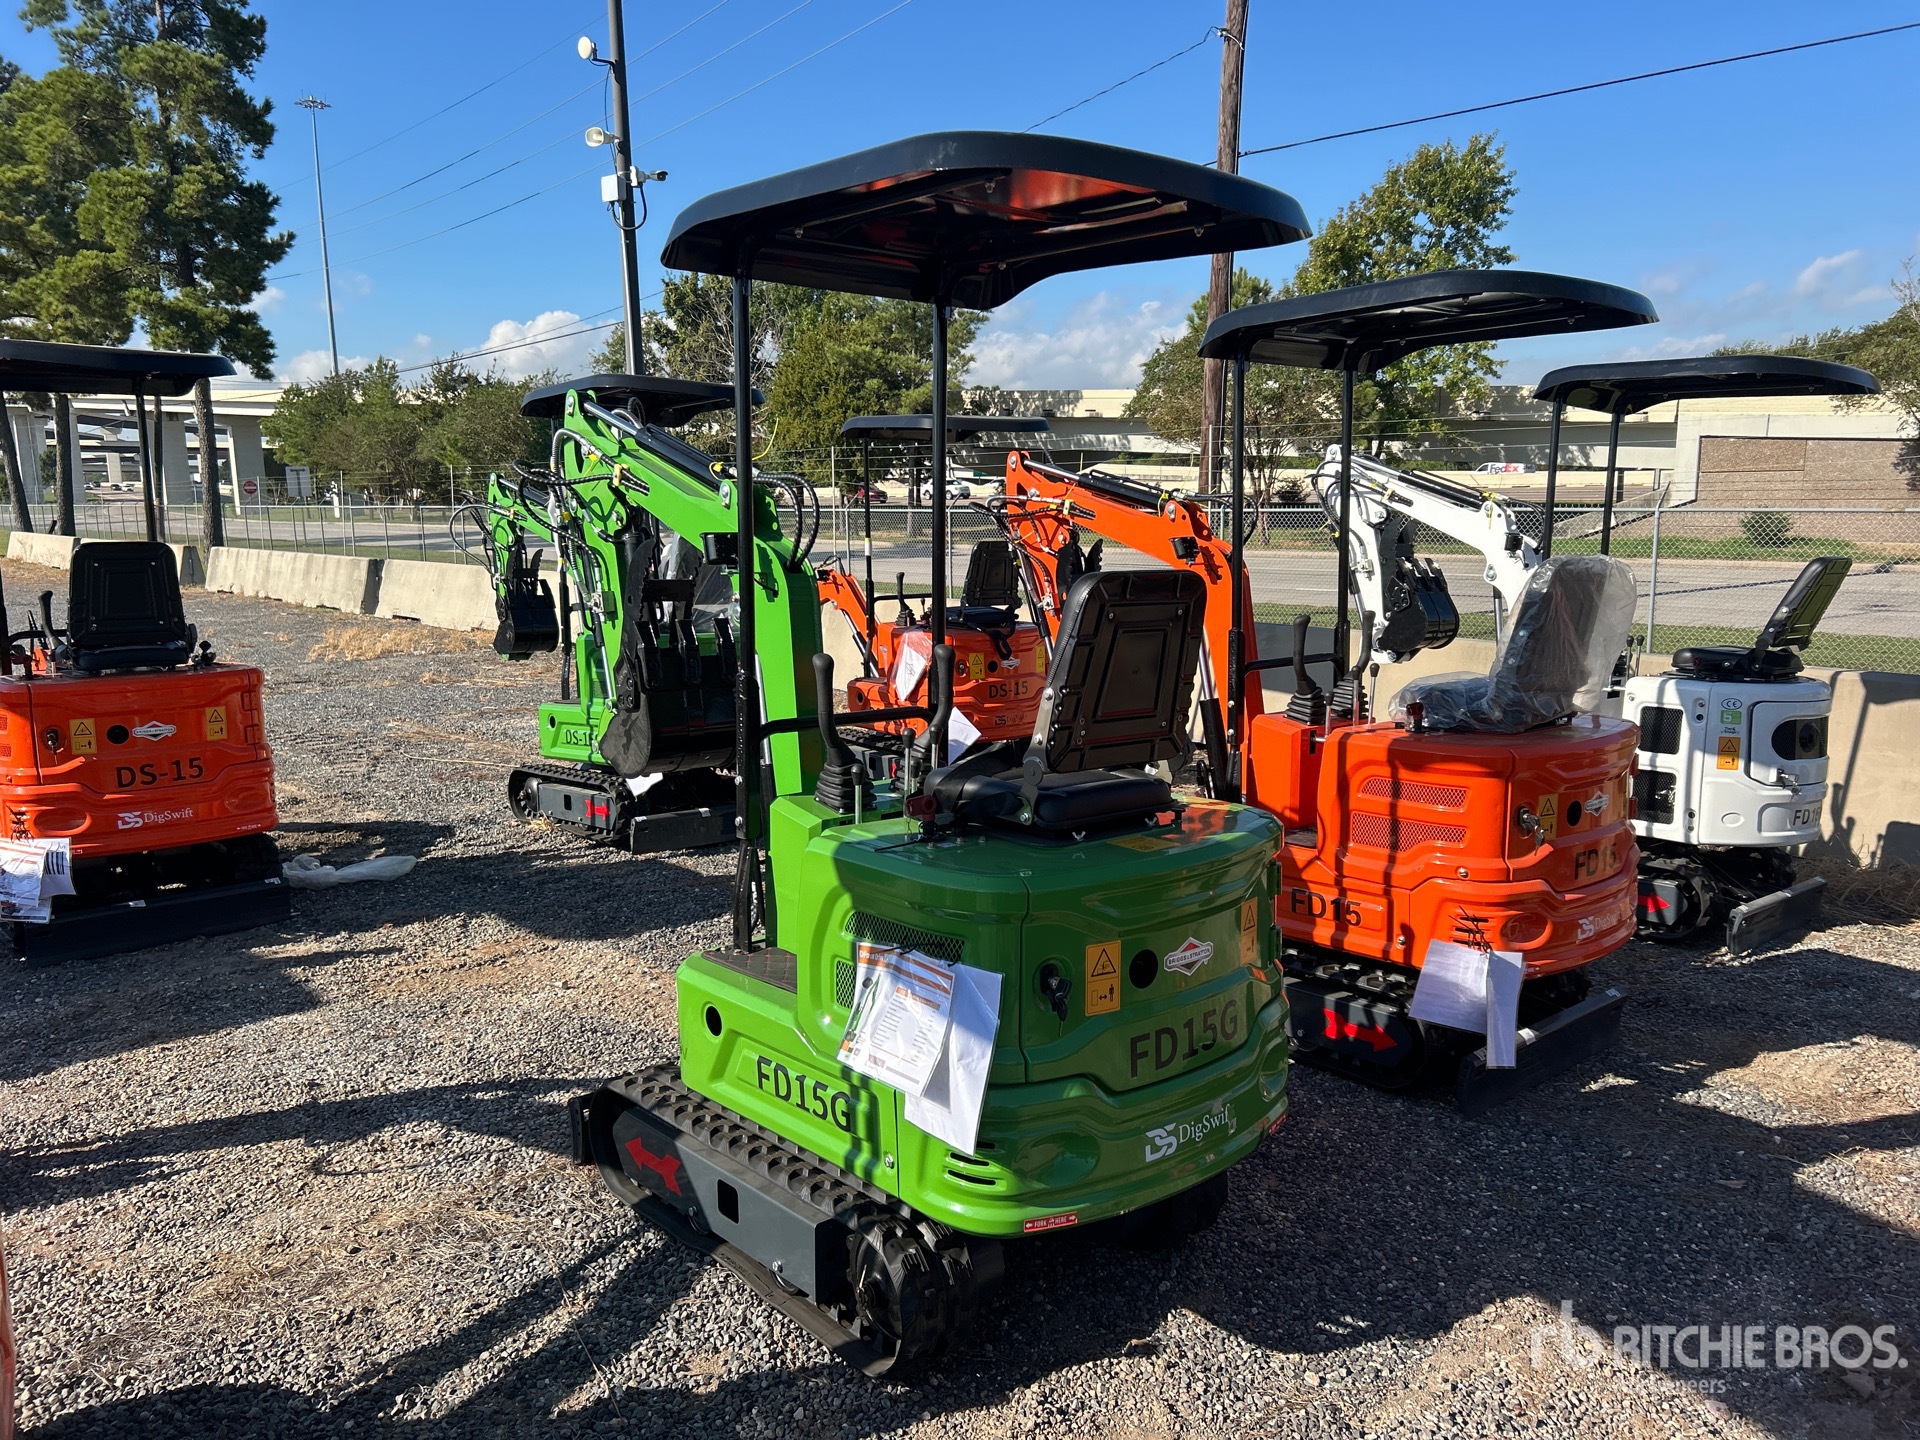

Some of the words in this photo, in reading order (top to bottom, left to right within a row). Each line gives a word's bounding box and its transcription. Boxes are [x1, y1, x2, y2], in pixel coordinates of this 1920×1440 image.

[1490, 462, 1519, 474] FedEx
[989, 681, 1028, 699] DS-15
[116, 757, 204, 788] DS-15
[144, 807, 194, 824] DigSwift
[1291, 888, 1362, 927] FD15
[1130, 999, 1238, 1078] FD15G
[757, 1054, 851, 1133] FD15G
[1034, 1220, 1047, 1228] FORK
[1054, 1216, 1067, 1224] HERE
